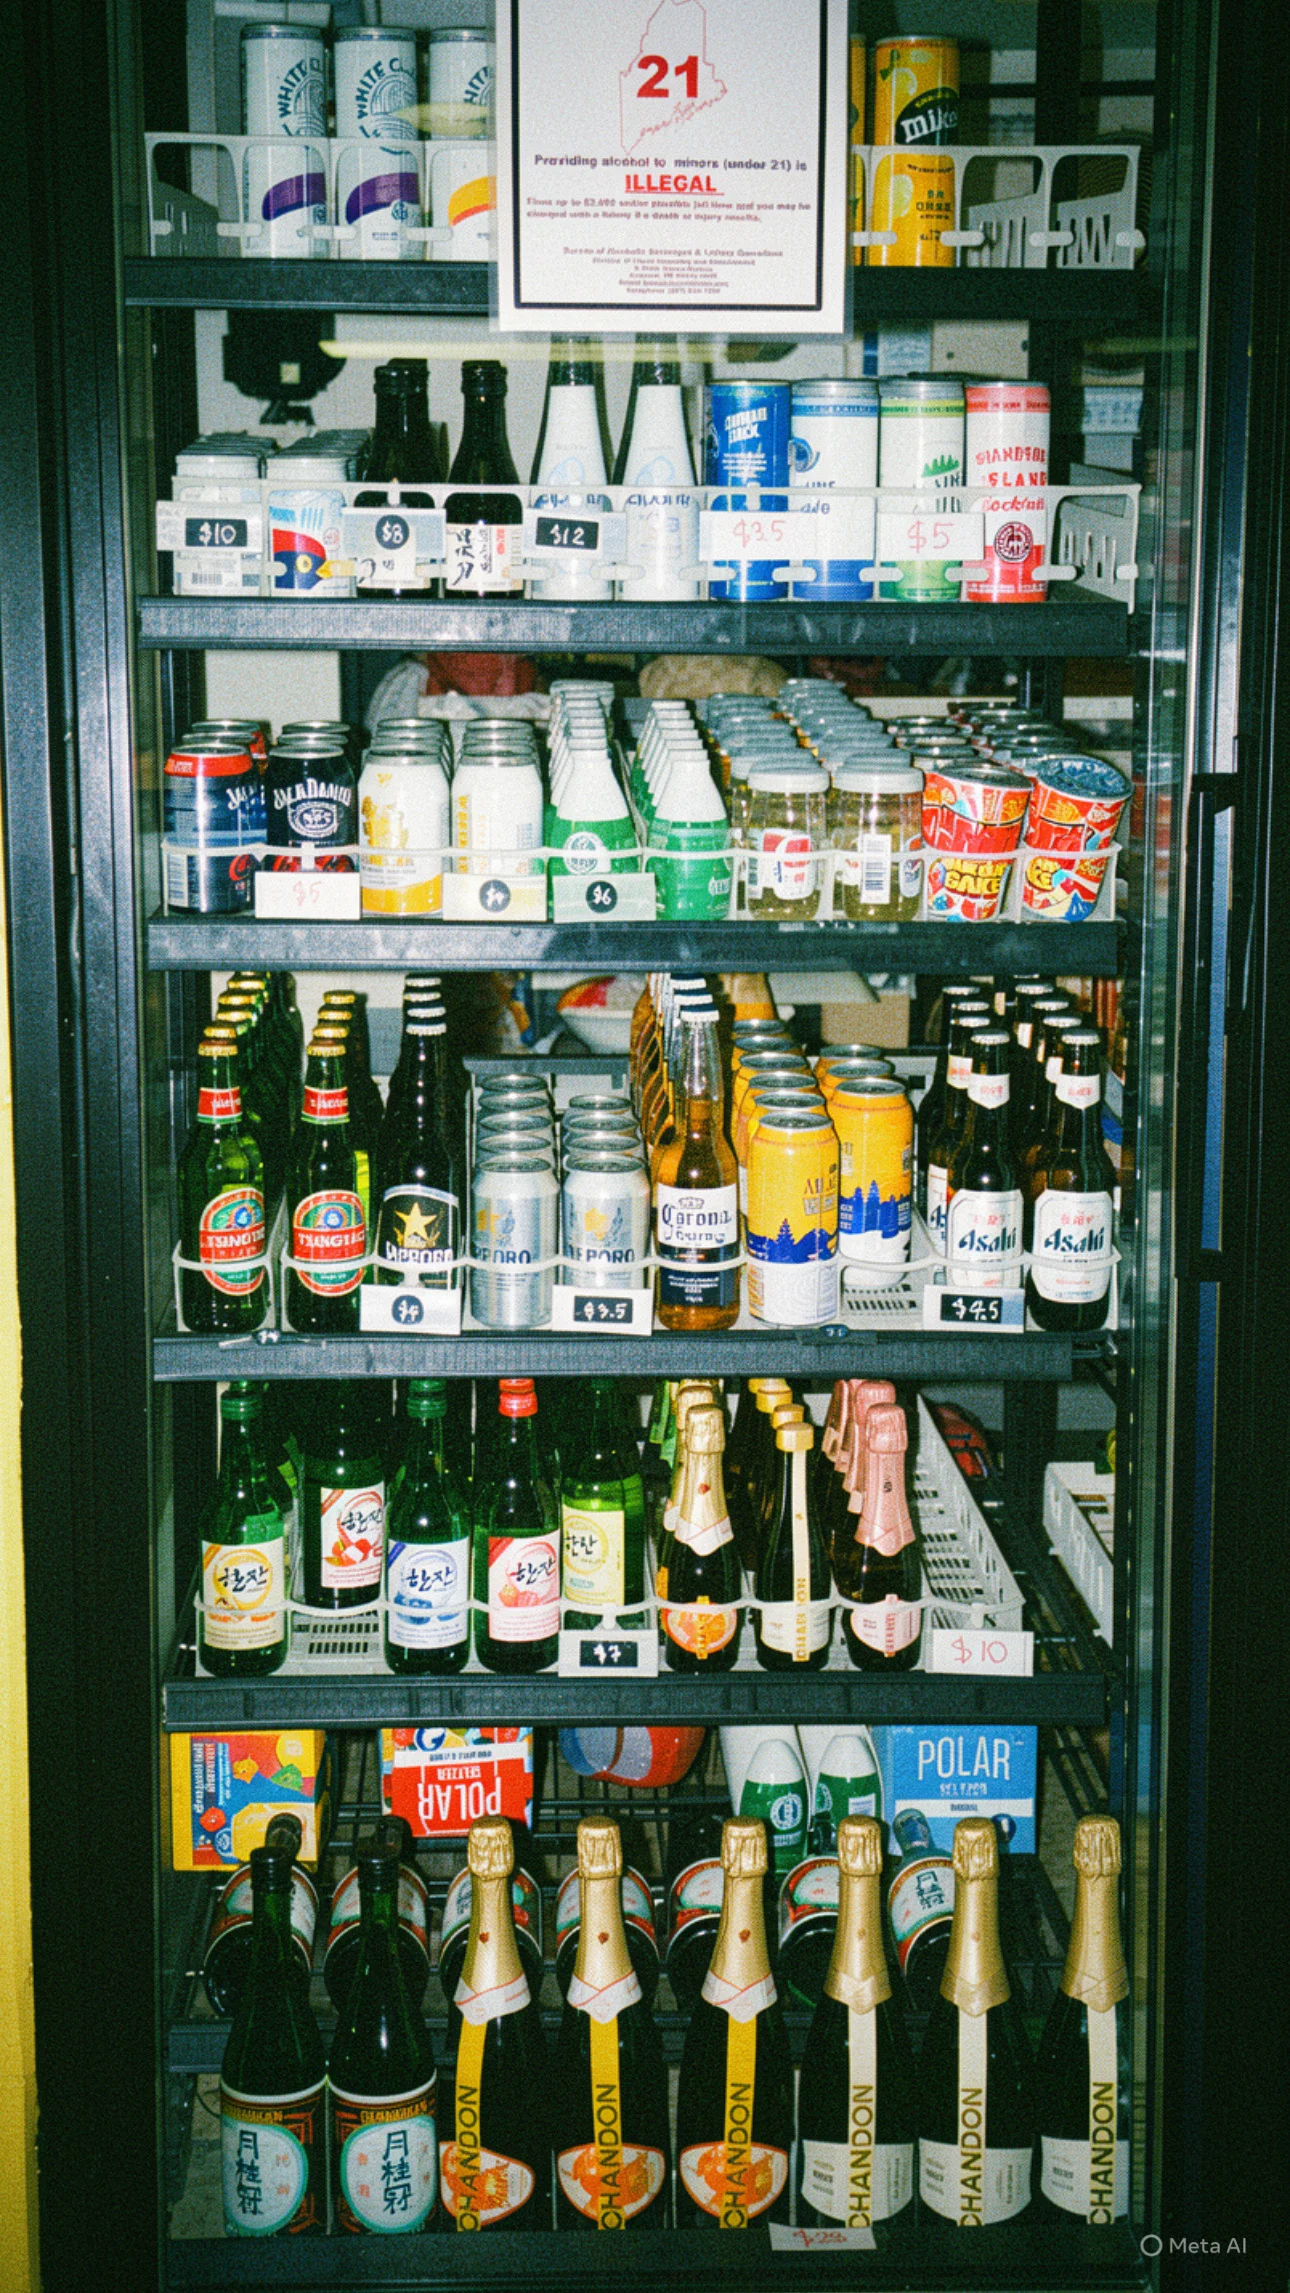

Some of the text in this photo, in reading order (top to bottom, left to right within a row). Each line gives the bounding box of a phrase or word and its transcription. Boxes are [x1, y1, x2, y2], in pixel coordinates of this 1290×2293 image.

[636, 55, 699, 98] 21
[534, 154, 598, 169] Providing
[602, 156, 650, 168] alcohol
[654, 157, 667, 168] to
[674, 157, 719, 169] minors
[770, 159, 792, 172] 21)
[796, 160, 808, 171] is
[625, 174, 717, 193] ILLEGAL
[199, 522, 236, 547] $10
[907, 520, 954, 553] $5
[958, 1226, 1017, 1252] Asahi
[1044, 1226, 1105, 1253] Asahi
[952, 1297, 999, 1321] $4.5
[952, 1636, 1008, 1664] $10
[918, 1735, 1010, 1781] POLAR
[417, 1776, 502, 1821] POLAR
[596, 2083, 623, 2229] CHANDON
[723, 2082, 751, 2228] CHANDON
[848, 2084, 874, 2228] CHANDON
[960, 2087, 983, 2226] CHANDON
[1091, 2082, 1114, 2225] CHANDON
